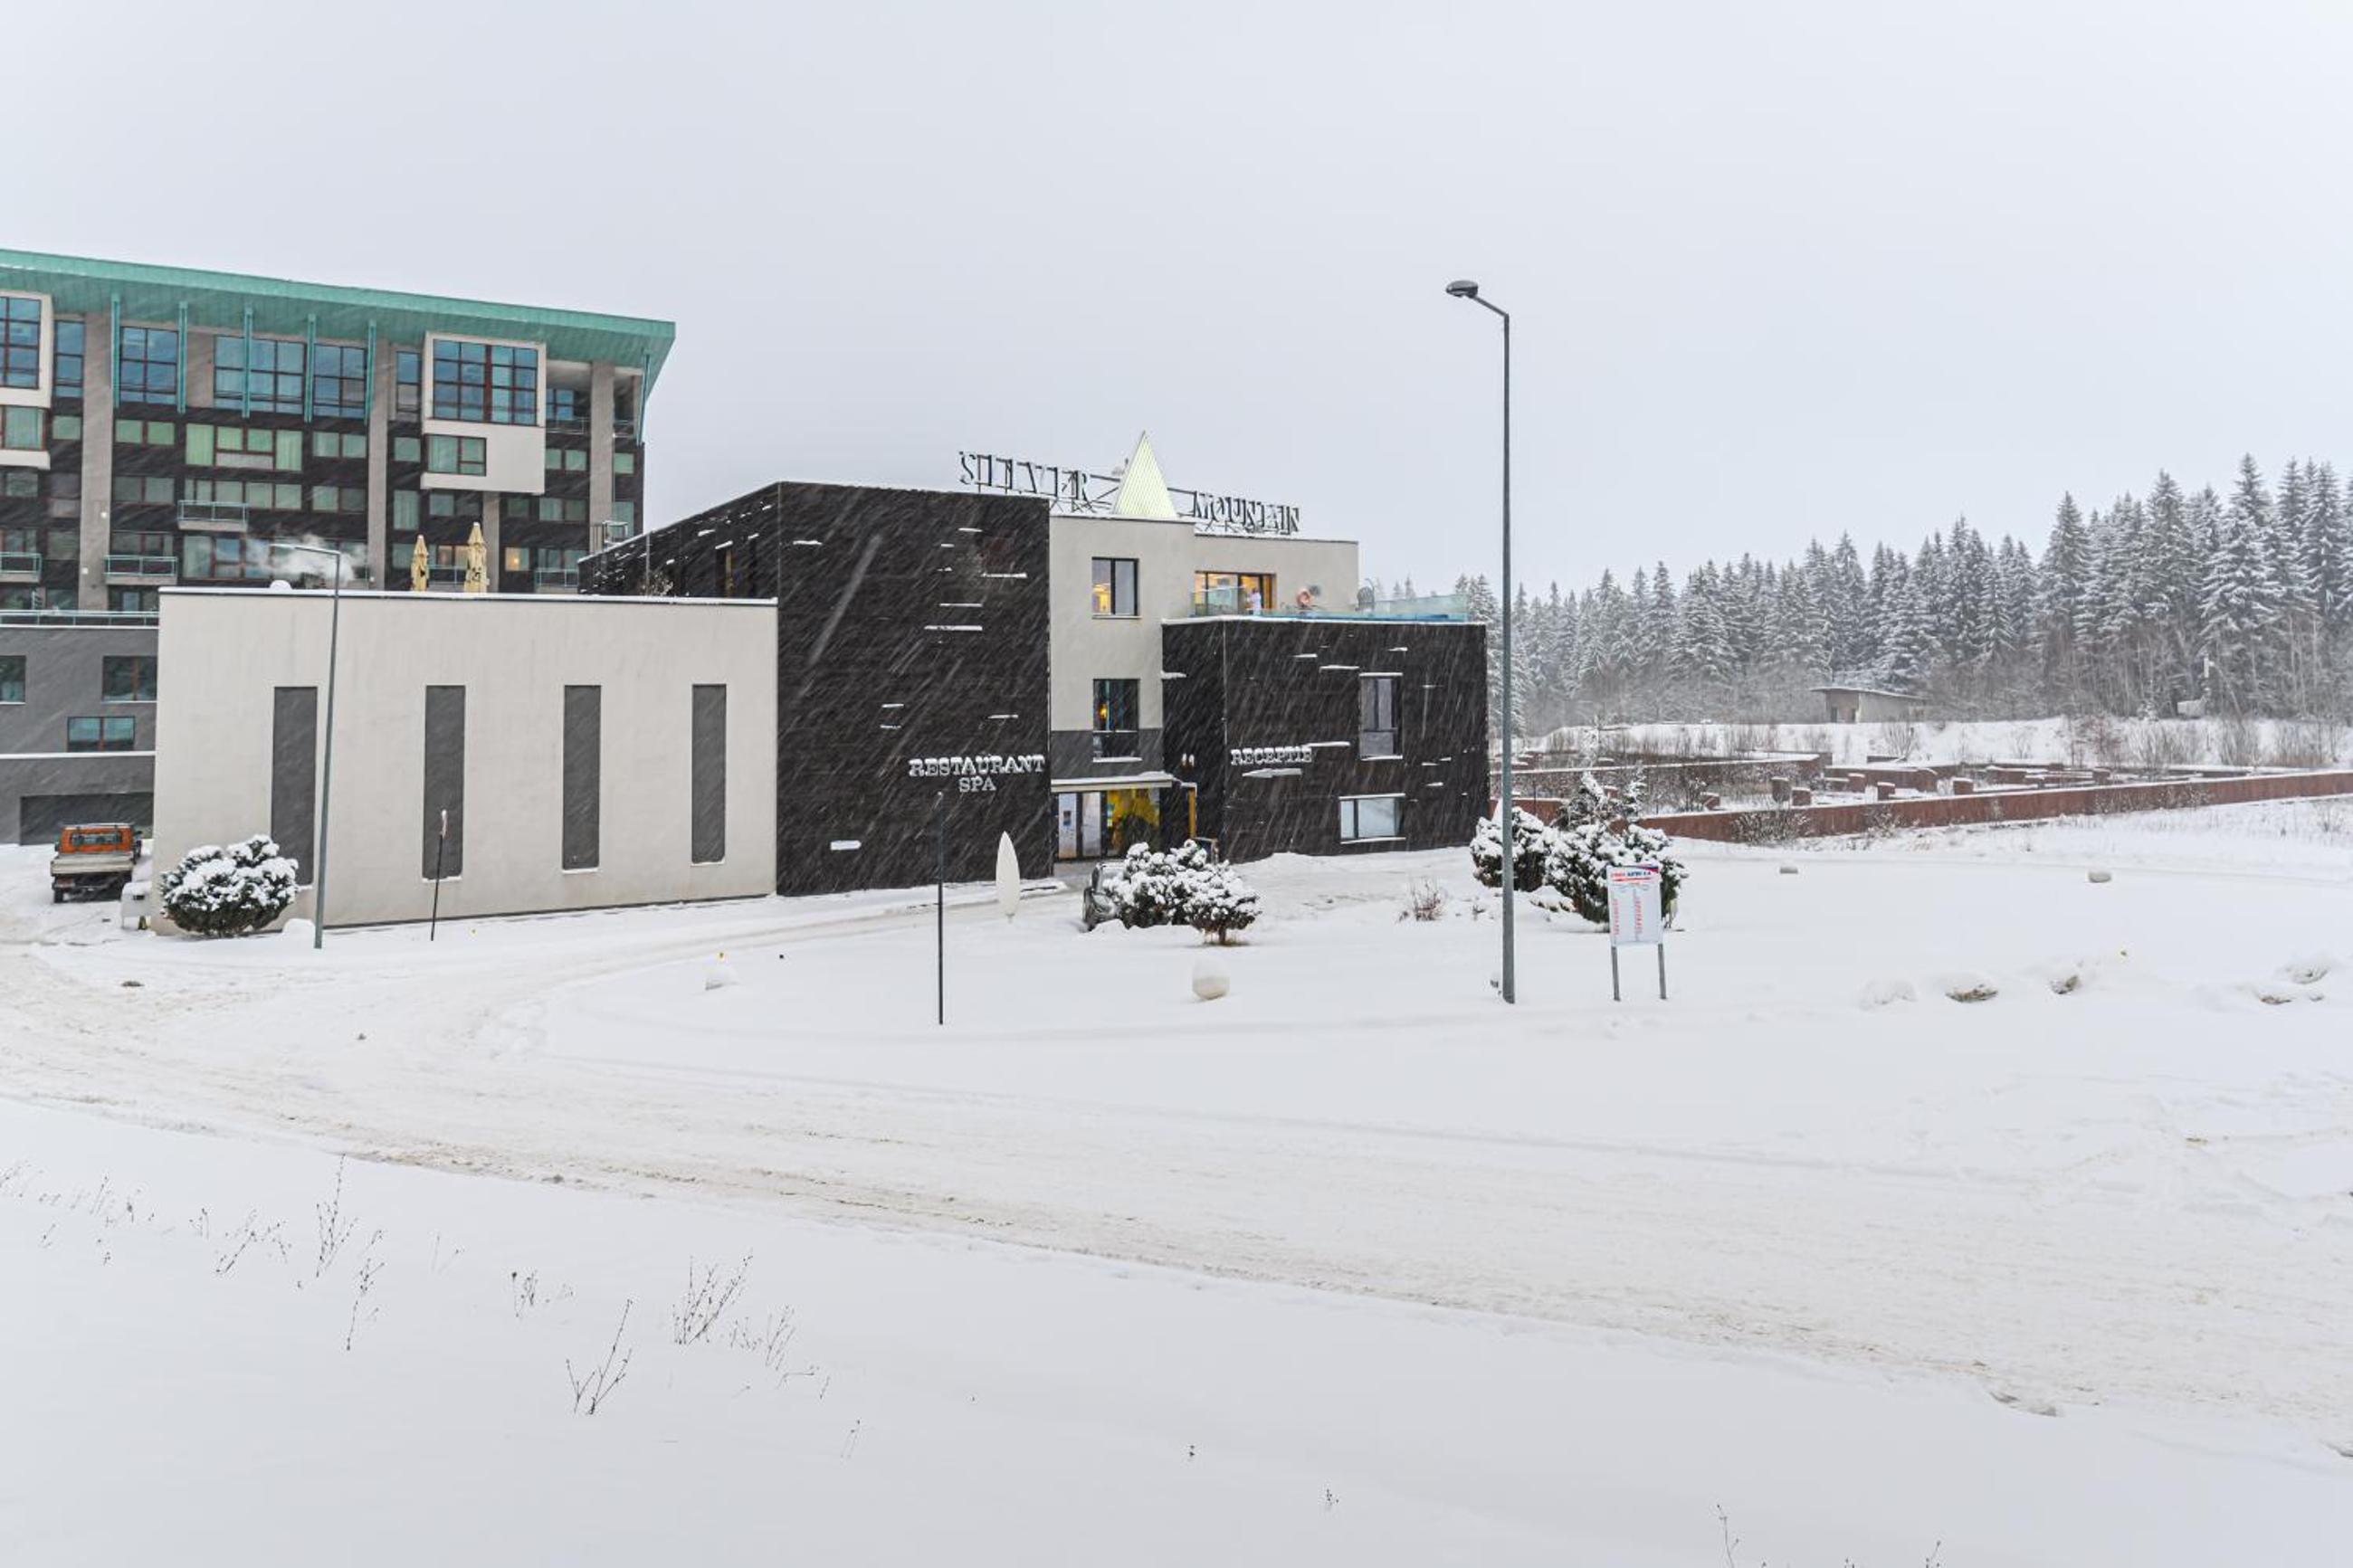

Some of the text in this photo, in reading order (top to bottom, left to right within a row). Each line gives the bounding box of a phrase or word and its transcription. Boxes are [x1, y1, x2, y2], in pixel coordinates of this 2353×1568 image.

[1231, 746, 1311, 765] RECEPTIE
[908, 755, 1045, 776] RESTAURANT
[958, 775, 996, 793] SPA
